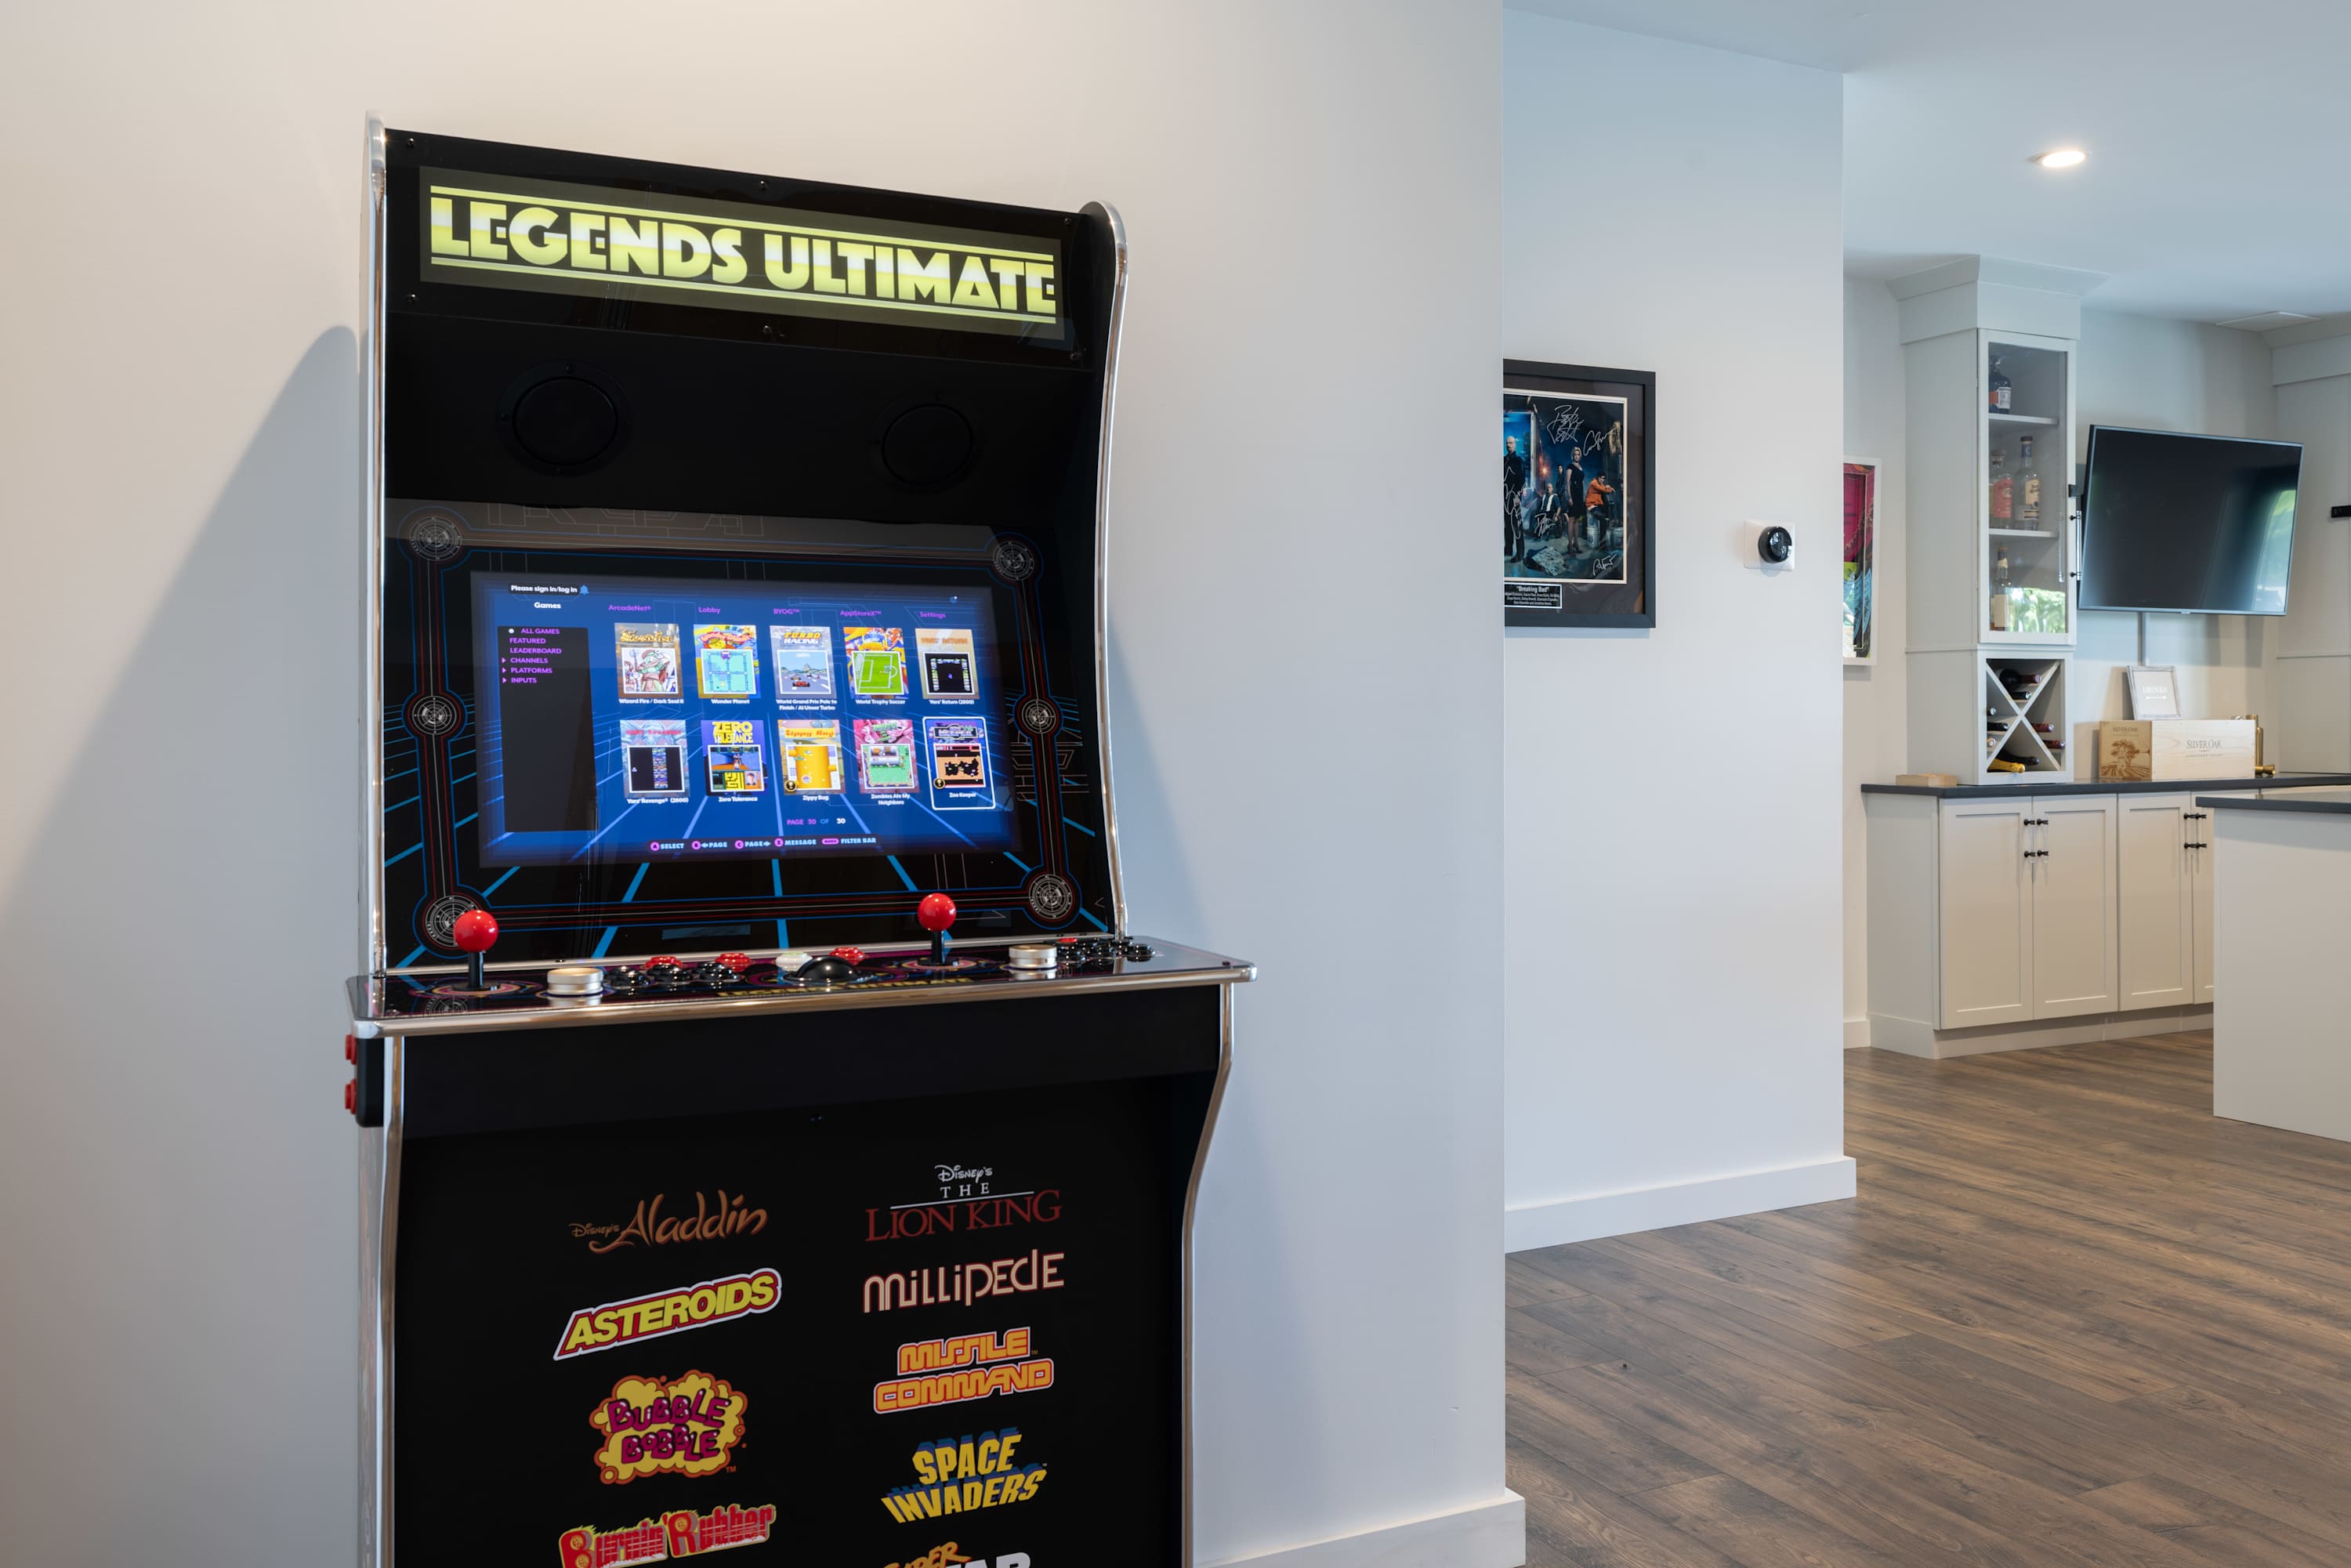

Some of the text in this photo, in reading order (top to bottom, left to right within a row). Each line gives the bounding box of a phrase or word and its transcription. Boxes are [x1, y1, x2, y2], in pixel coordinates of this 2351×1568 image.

[430, 197, 1056, 313] LEGENDS ULTIMATE
[712, 721, 753, 733] ZERO
[2186, 739, 2222, 749] SILVER OAK
[935, 1165, 993, 1183] Disney's
[940, 1182, 990, 1198] THE
[568, 1190, 768, 1254] Disney's Aladdin
[865, 1190, 1062, 1242] LION KING
[560, 1271, 778, 1356] ASTEROIDS
[897, 1327, 1031, 1375] MISSILE
[607, 1388, 732, 1433] BUBBLE
[875, 1359, 1054, 1414] COMMAND
[621, 1424, 721, 1465] BOBBLE
[912, 1431, 1022, 1485] SPACE
[881, 1468, 1047, 1523] INVADERS
[668, 1504, 776, 1559] Rubber
